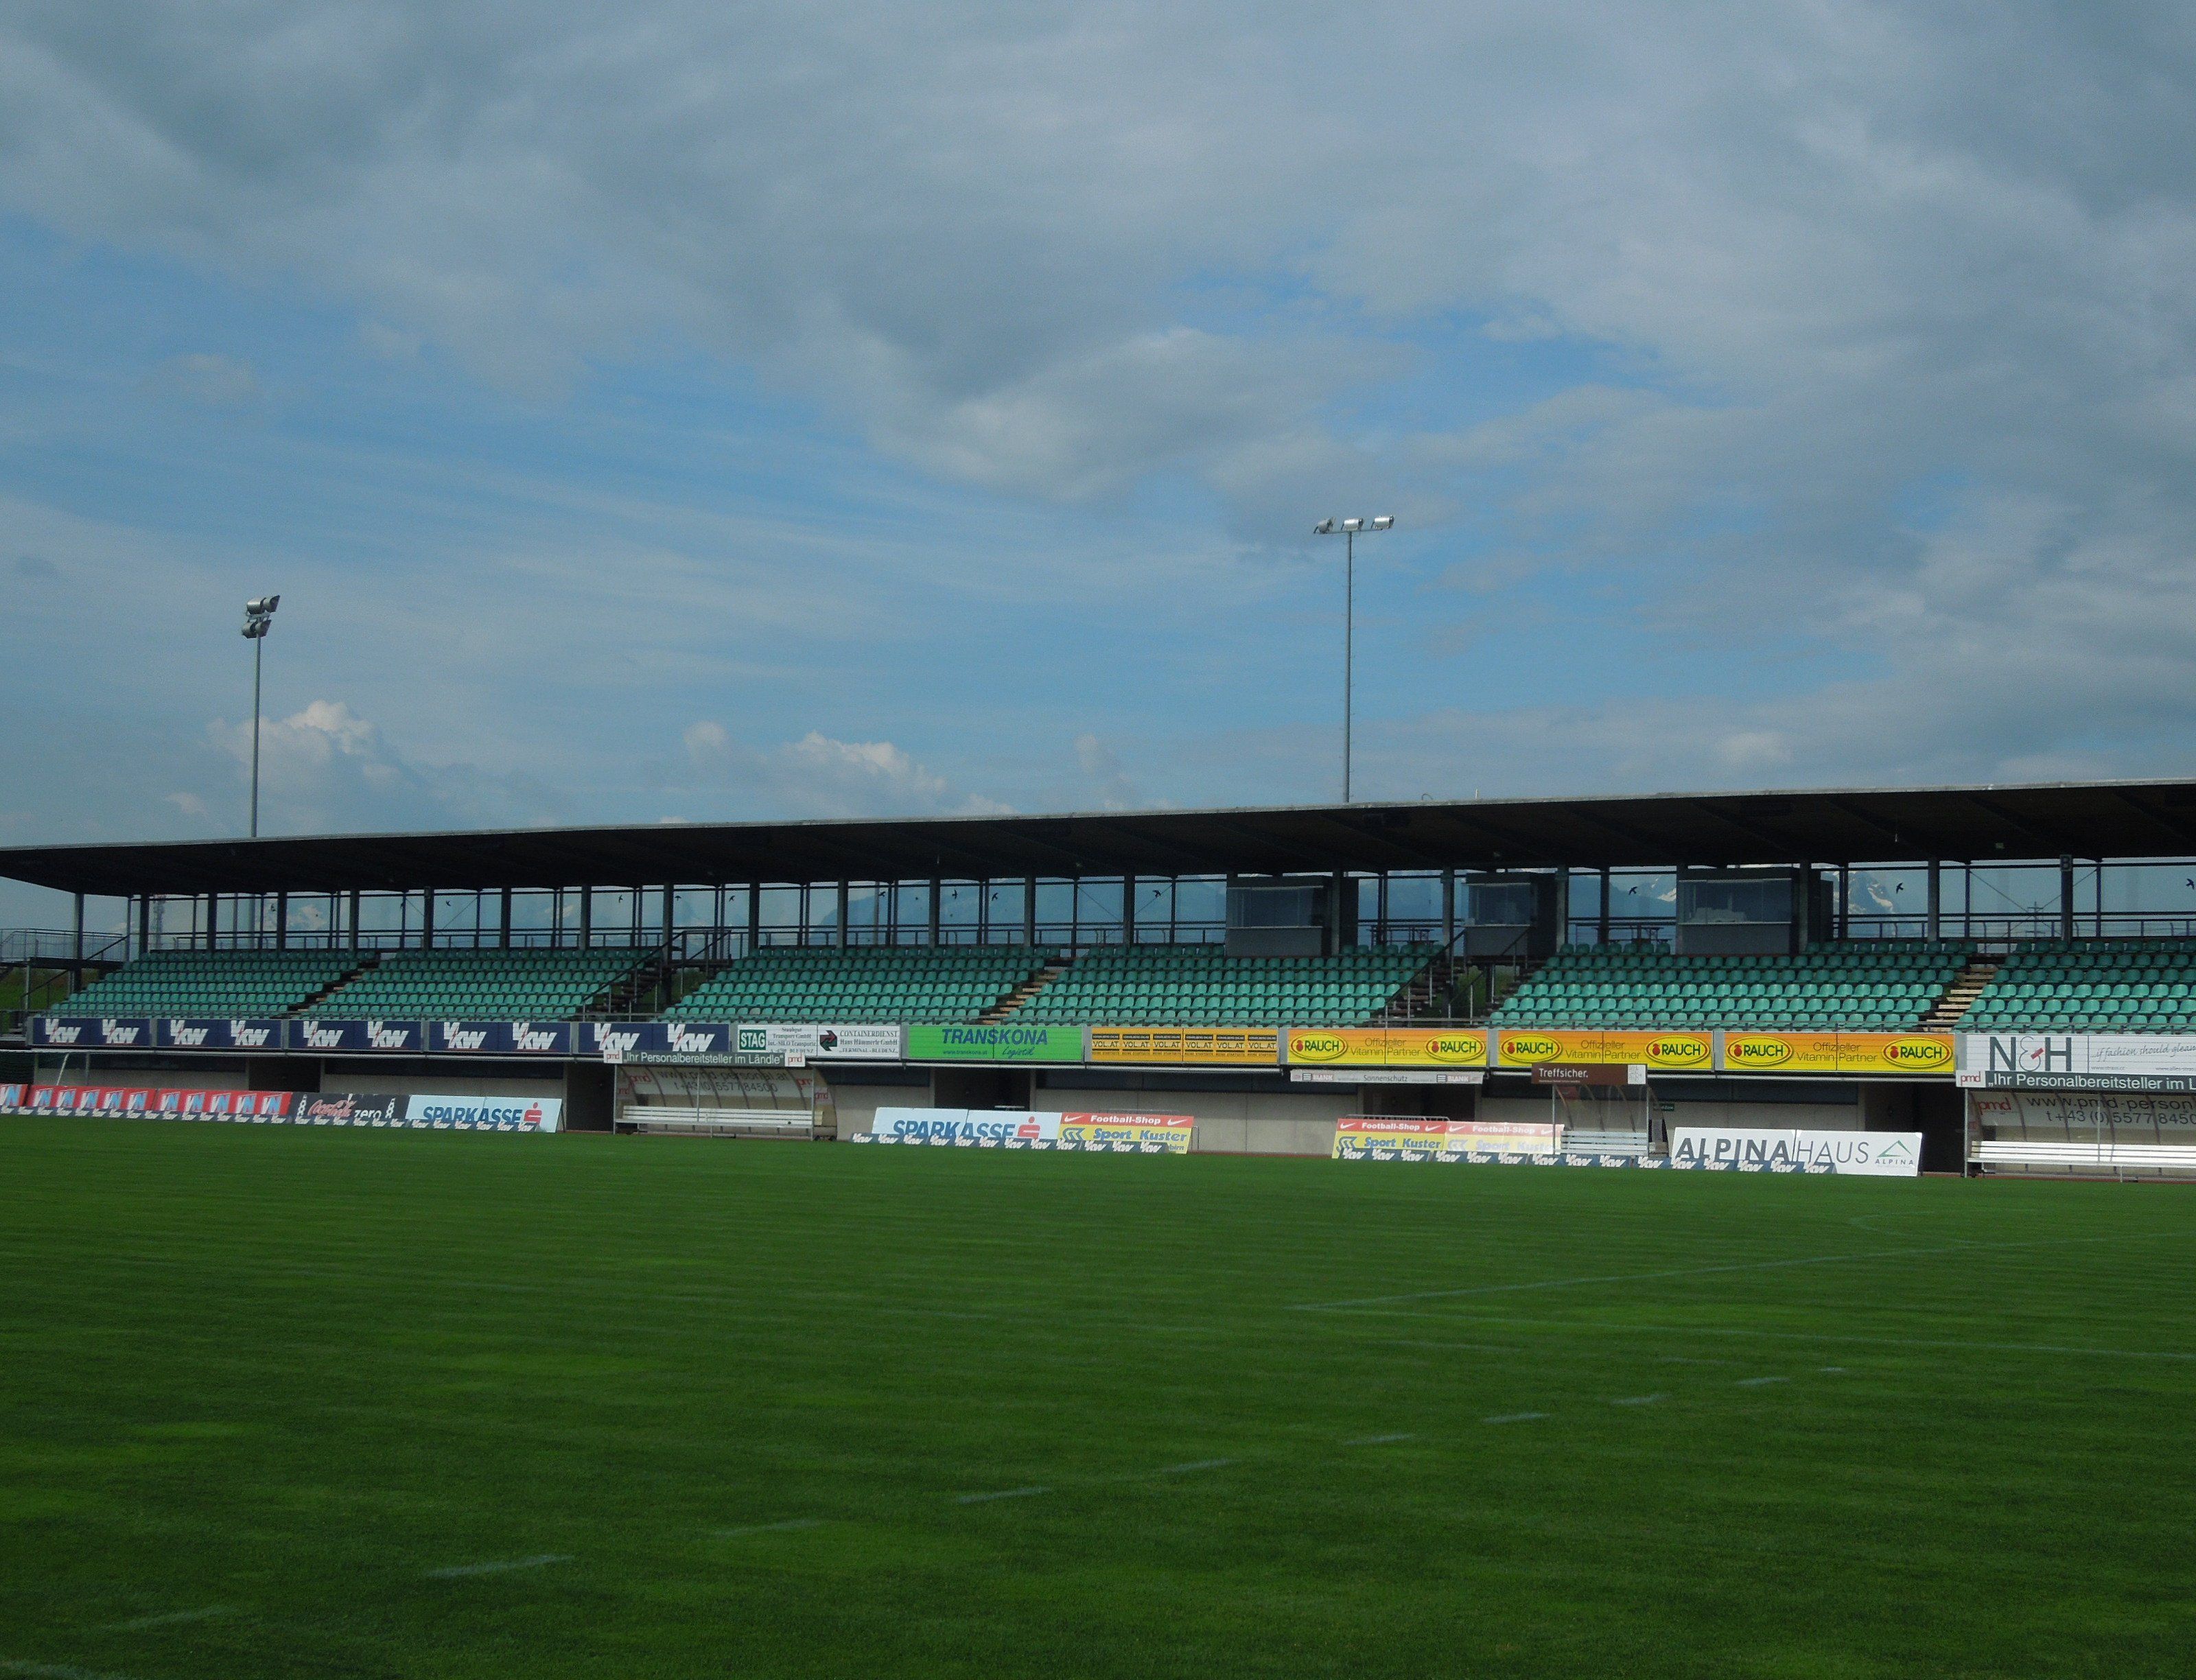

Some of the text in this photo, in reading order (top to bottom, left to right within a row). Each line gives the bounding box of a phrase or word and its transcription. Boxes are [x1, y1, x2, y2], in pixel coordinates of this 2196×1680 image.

[45, 1018, 81, 1043] VKW
[102, 1018, 139, 1044] VKW
[170, 1019, 208, 1045] VKW
[231, 1020, 270, 1046] VKW
[303, 1020, 343, 1047] VKW
[368, 1021, 408, 1047] VKW
[444, 1022, 487, 1049] VKW
[513, 1023, 557, 1049] VKW
[594, 1023, 640, 1051] VKW
[668, 1023, 715, 1051] VKW
[942, 1029, 1048, 1045] TRANSKONA
[740, 1032, 766, 1048] STAG
[1305, 1040, 1340, 1051] RAUCH
[1440, 1040, 1477, 1053] RAUCH
[1002, 1046, 1035, 1058] Logistik
[1351, 1047, 1421, 1056] Vitamin Partner
[1516, 1042, 1554, 1054] RAUCH
[1565, 1049, 1641, 1060] Vitamin Partner
[1661, 1043, 1701, 1056] RAUCH
[1744, 1045, 1784, 1057] RAUCH
[1900, 1046, 1942, 1059] RAUCH
[641, 1052, 733, 1064] Personalbereitsteller
[734, 1054, 746, 1064] im
[1796, 1051, 1878, 1062] Vitamin Partner
[1364, 1074, 1407, 1082] Sonnenschutz
[1539, 1068, 1589, 1078] Treffsicher.
[1960, 1074, 1981, 1086] pmd
[2016, 1074, 2162, 1090] Personalbereitsteller
[2166, 1077, 2184, 1090] im
[1977, 1097, 2012, 1115] pmd
[353, 1109, 382, 1119] zero
[423, 1106, 523, 1123] SPARKASSE
[1090, 1115, 1161, 1125] Football-Shop
[2046, 1110, 2053, 1121] t
[2113, 1112, 2153, 1124] 5577
[893, 1119, 1016, 1139] SPARKASSE
[1362, 1122, 1421, 1131] Football-Shop
[1472, 1125, 1536, 1134] Football-Shop
[1093, 1128, 1187, 1141] Sport Kuster
[1364, 1136, 1442, 1149] Sport Kuster
[1675, 1137, 1869, 1164] ALPINA HAUS
